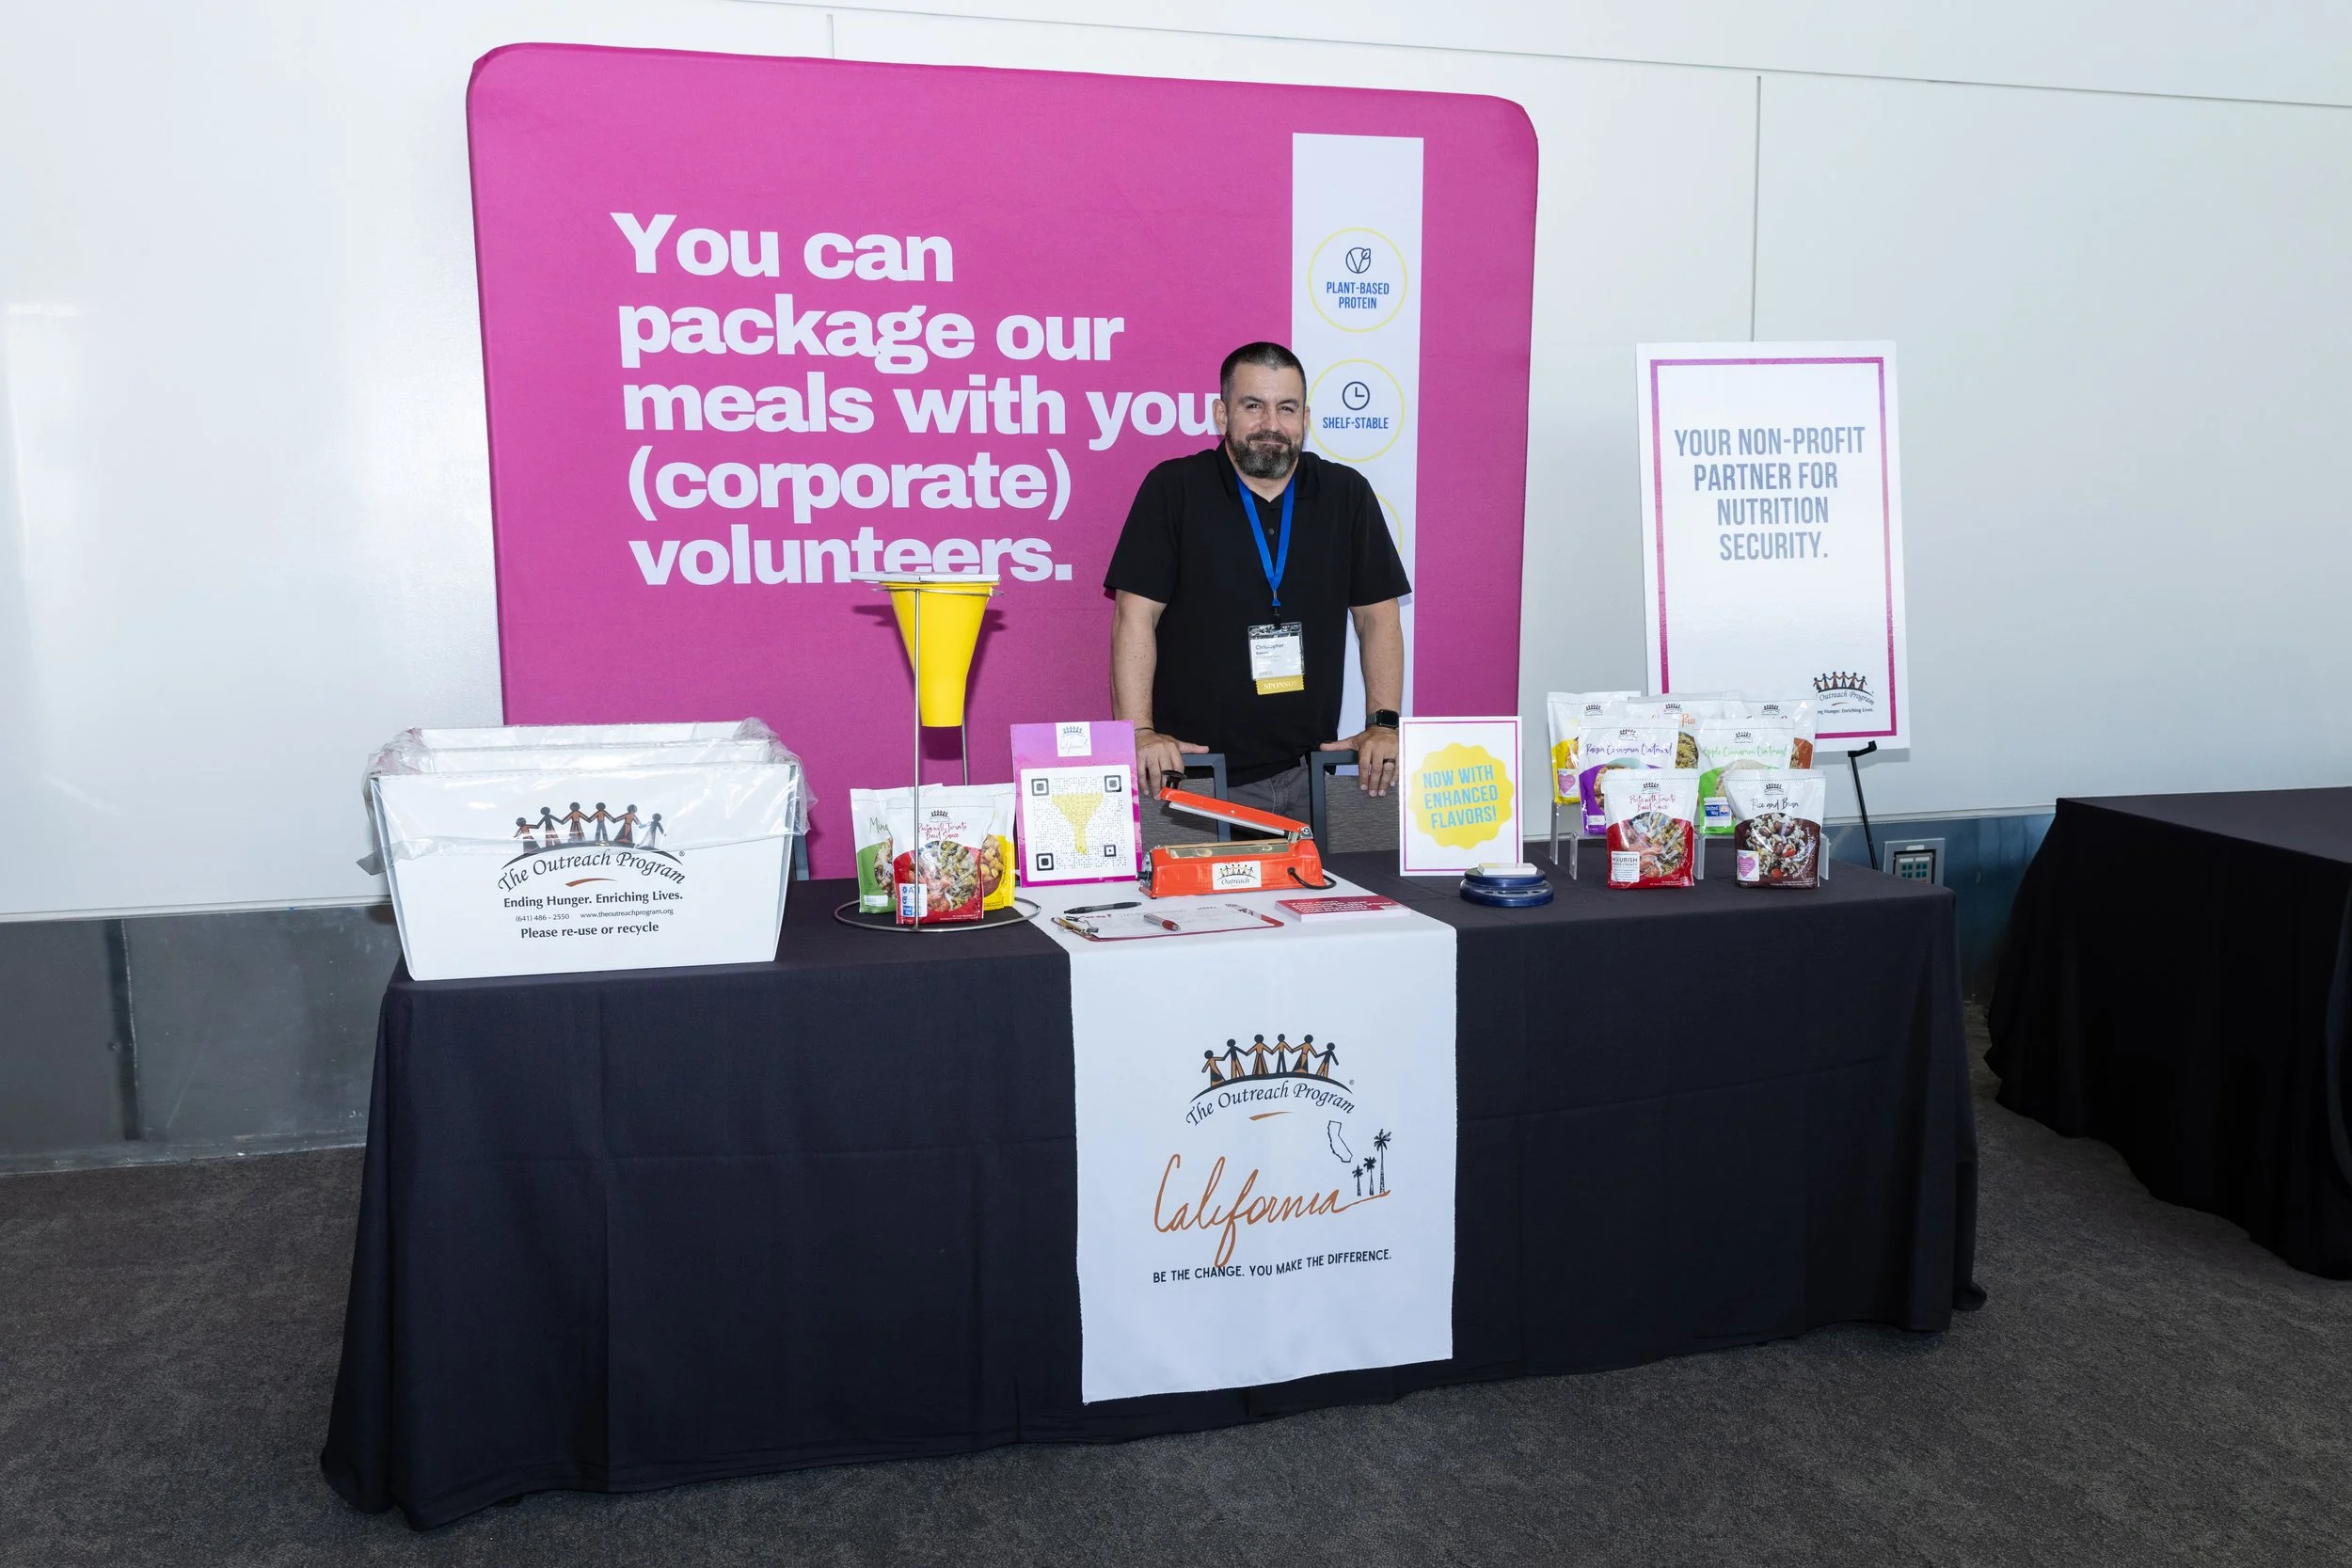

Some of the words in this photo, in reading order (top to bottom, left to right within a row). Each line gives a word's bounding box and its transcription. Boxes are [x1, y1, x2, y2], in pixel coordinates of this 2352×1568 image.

[610, 213, 780, 277] You
[803, 232, 954, 282] can
[1327, 281, 1390, 294] PLANT-BASED
[1338, 296, 1377, 309] PROTEIN
[618, 293, 976, 374] package
[995, 315, 1125, 361] our
[623, 372, 875, 433] meals
[894, 374, 1067, 435] with
[1323, 417, 1389, 430] SHELF-STABLE
[1675, 429, 1731, 456] YOUR
[1739, 426, 1866, 455] NON-PROFIT
[628, 446, 1072, 524] (corporate)
[1693, 463, 1790, 491] PARTNER
[1798, 461, 1838, 489] FOR
[1717, 497, 1829, 526] NUTRITION
[628, 524, 1073, 585] volunteers.
[1720, 531, 1829, 561] SECURITY.
[1820, 690, 1848, 701] Outreach
[1849, 691, 1874, 705] Program
[1423, 769, 1454, 788] NOW
[1458, 765, 1494, 784] WITH
[1424, 784, 1498, 810] ENHANCED
[1750, 799, 1765, 810] Rice
[1766, 800, 1779, 810] and
[1430, 805, 1498, 830] FLAVORS!
[498, 868, 529, 892] The
[532, 851, 612, 876] Outreach
[615, 851, 686, 884] Program
[1221, 877, 1250, 885] Outreach
[503, 896, 544, 910] Ending
[547, 895, 592, 909] Hunger.
[596, 892, 649, 906] Enriching
[652, 890, 683, 901] Lives.
[516, 913, 532, 923] (641)
[580, 908, 674, 920] www.theoutreachprogram.org
[520, 927, 558, 939] Please
[561, 927, 597, 937] re-use
[601, 927, 614, 936] or
[617, 921, 660, 935] recycle
[1185, 1101, 1215, 1127] The
[1217, 1080, 1290, 1108] Outreach
[1293, 1083, 1355, 1115] Program
[1153, 1153, 1391, 1269] California
[1153, 1272, 1167, 1284] BE
[1170, 1269, 1190, 1281] THE
[1194, 1265, 1245, 1279] CHANGE.
[1249, 1264, 1273, 1276] YOU
[1276, 1258, 1303, 1275] MAKE
[1307, 1255, 1325, 1268] THE
[1327, 1249, 1392, 1265] DIFFERENCE.
